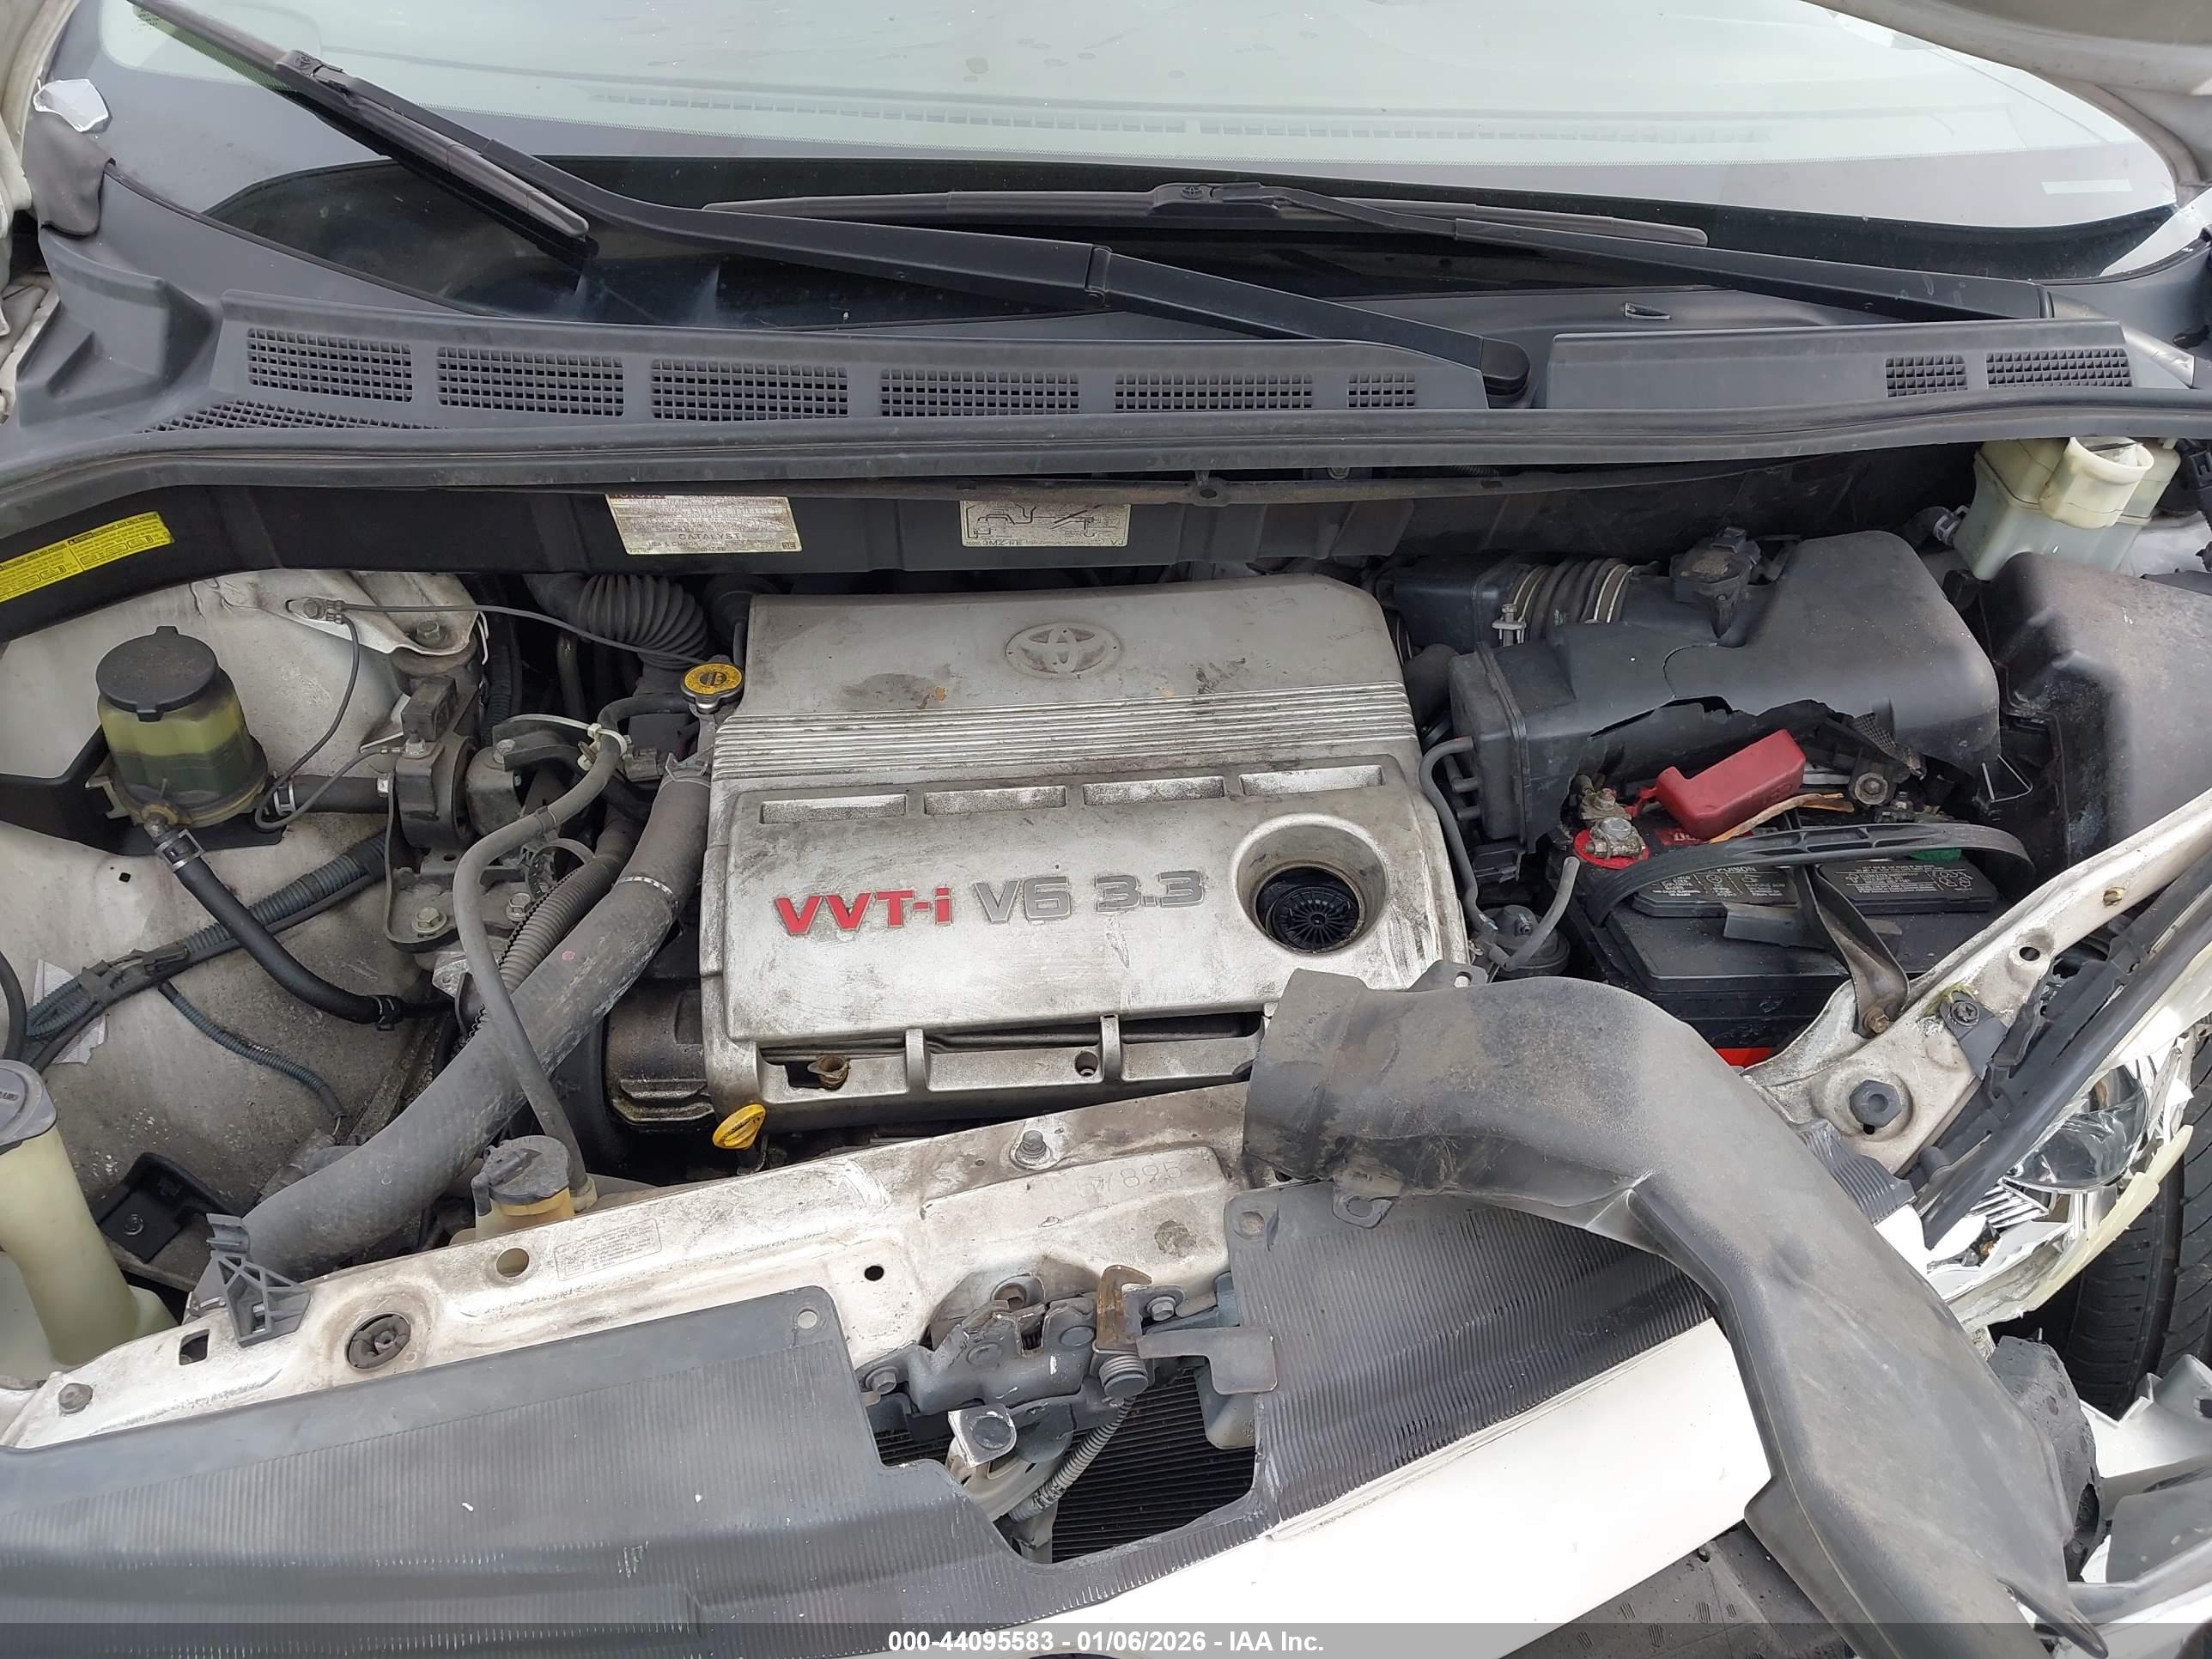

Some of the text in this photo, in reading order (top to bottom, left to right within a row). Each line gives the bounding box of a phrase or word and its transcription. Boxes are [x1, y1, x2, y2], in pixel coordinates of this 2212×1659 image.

[775, 869, 1205, 936] VVT-i V6 3.3
